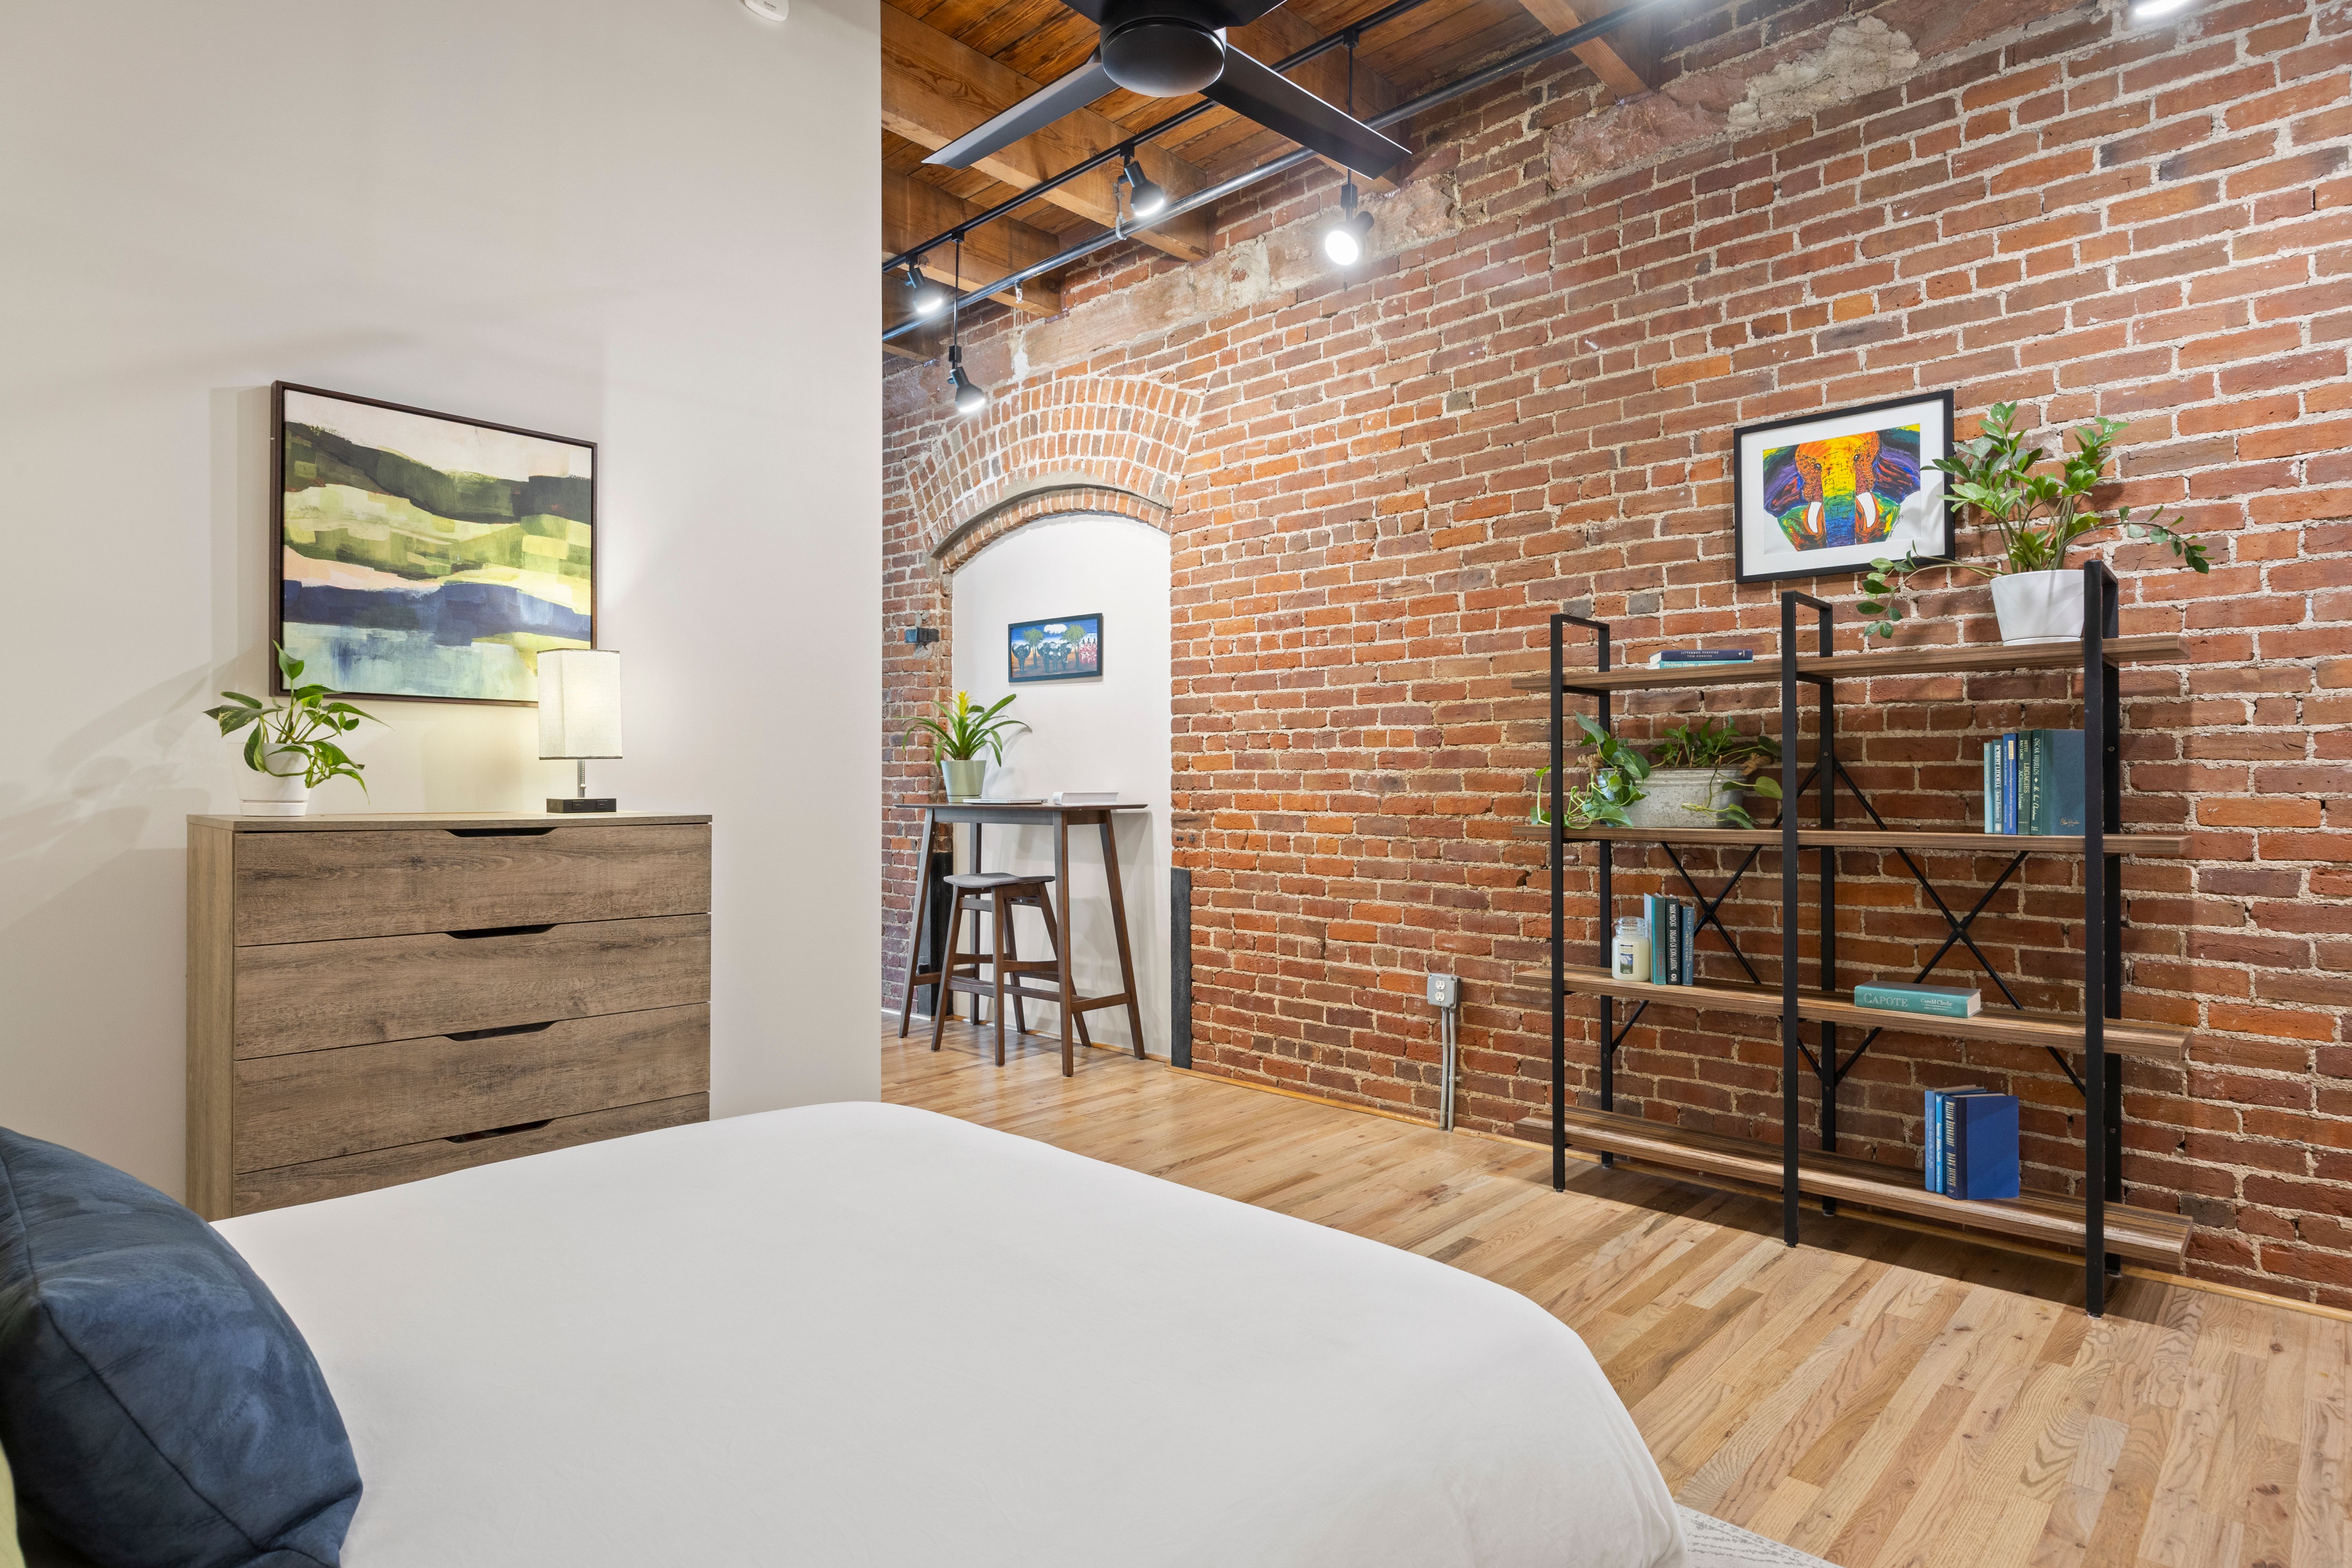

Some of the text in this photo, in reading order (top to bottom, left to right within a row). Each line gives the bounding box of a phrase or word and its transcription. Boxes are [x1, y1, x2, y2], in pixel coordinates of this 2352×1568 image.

[1863, 993, 1908, 1007] CAPOTE
[1945, 1101, 1955, 1120] WILLIAM
[1945, 1120, 1955, 1147] BERNHARDT
[1946, 1152, 1956, 1167] DARK
[1946, 1165, 1956, 1187] JUSTICE
